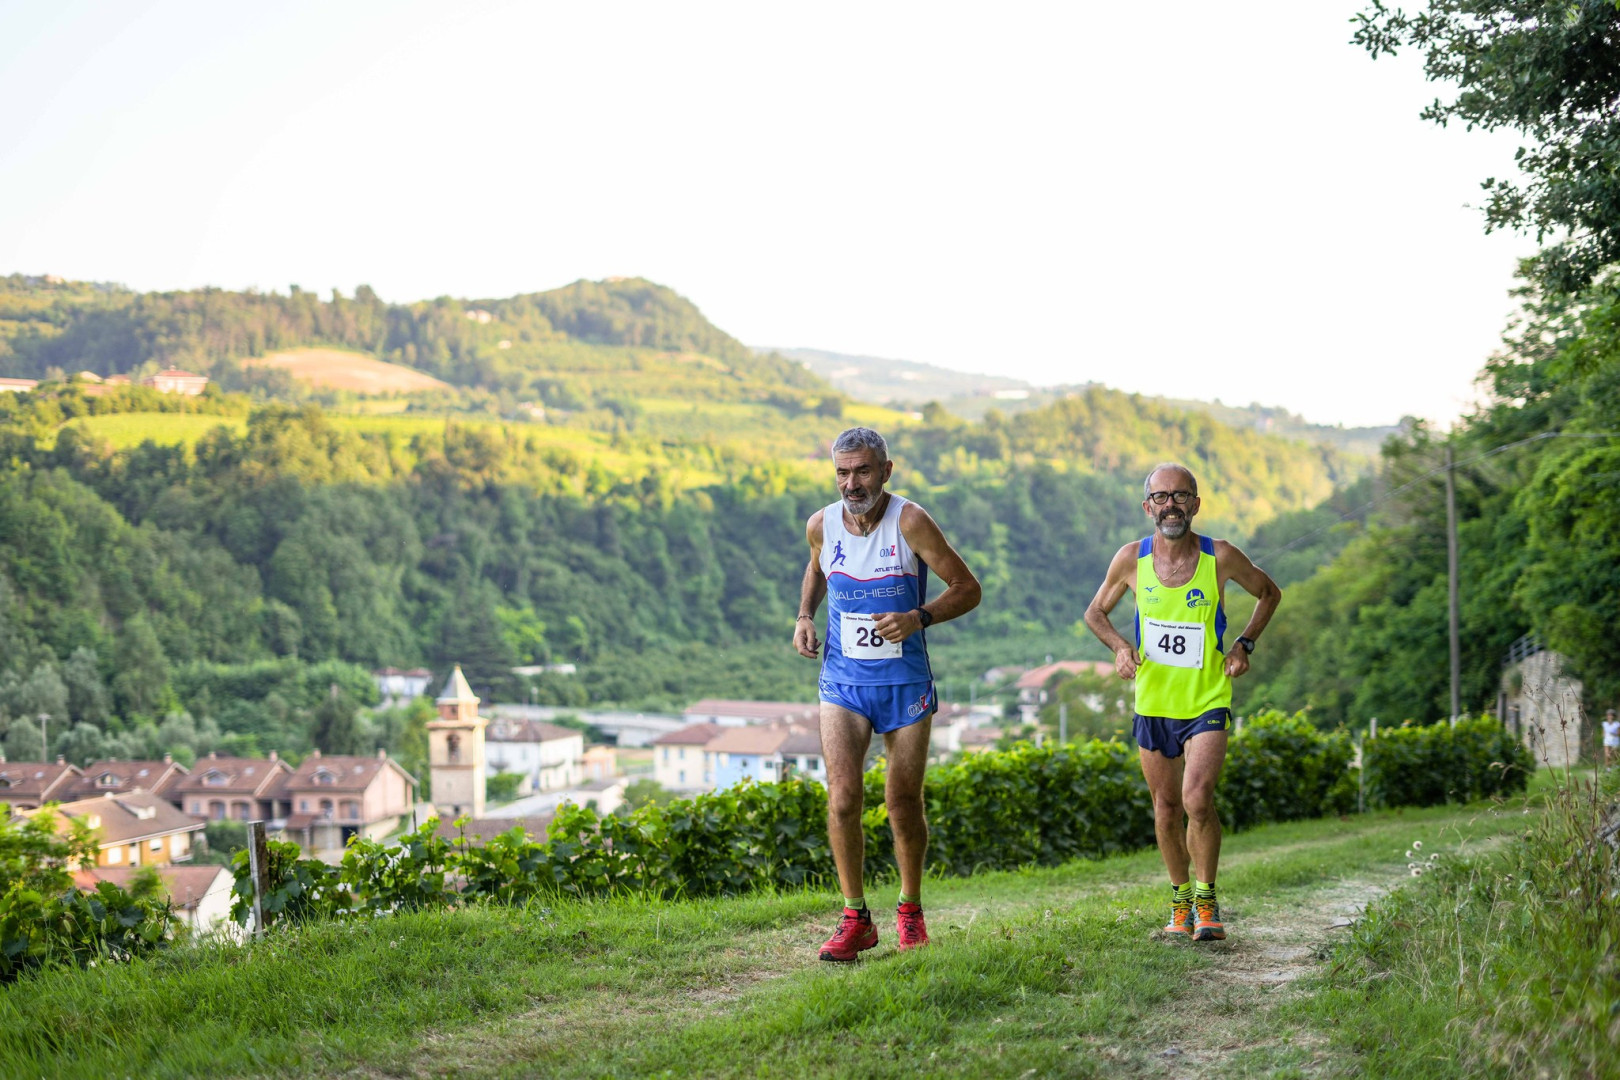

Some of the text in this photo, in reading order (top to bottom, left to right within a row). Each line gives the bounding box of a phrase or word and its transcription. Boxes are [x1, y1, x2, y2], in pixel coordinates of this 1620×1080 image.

[880, 545, 896, 558] OMZ
[832, 585, 905, 600] VALCHIESE
[856, 627, 884, 647] 28
[1158, 633, 1186, 655] 48
